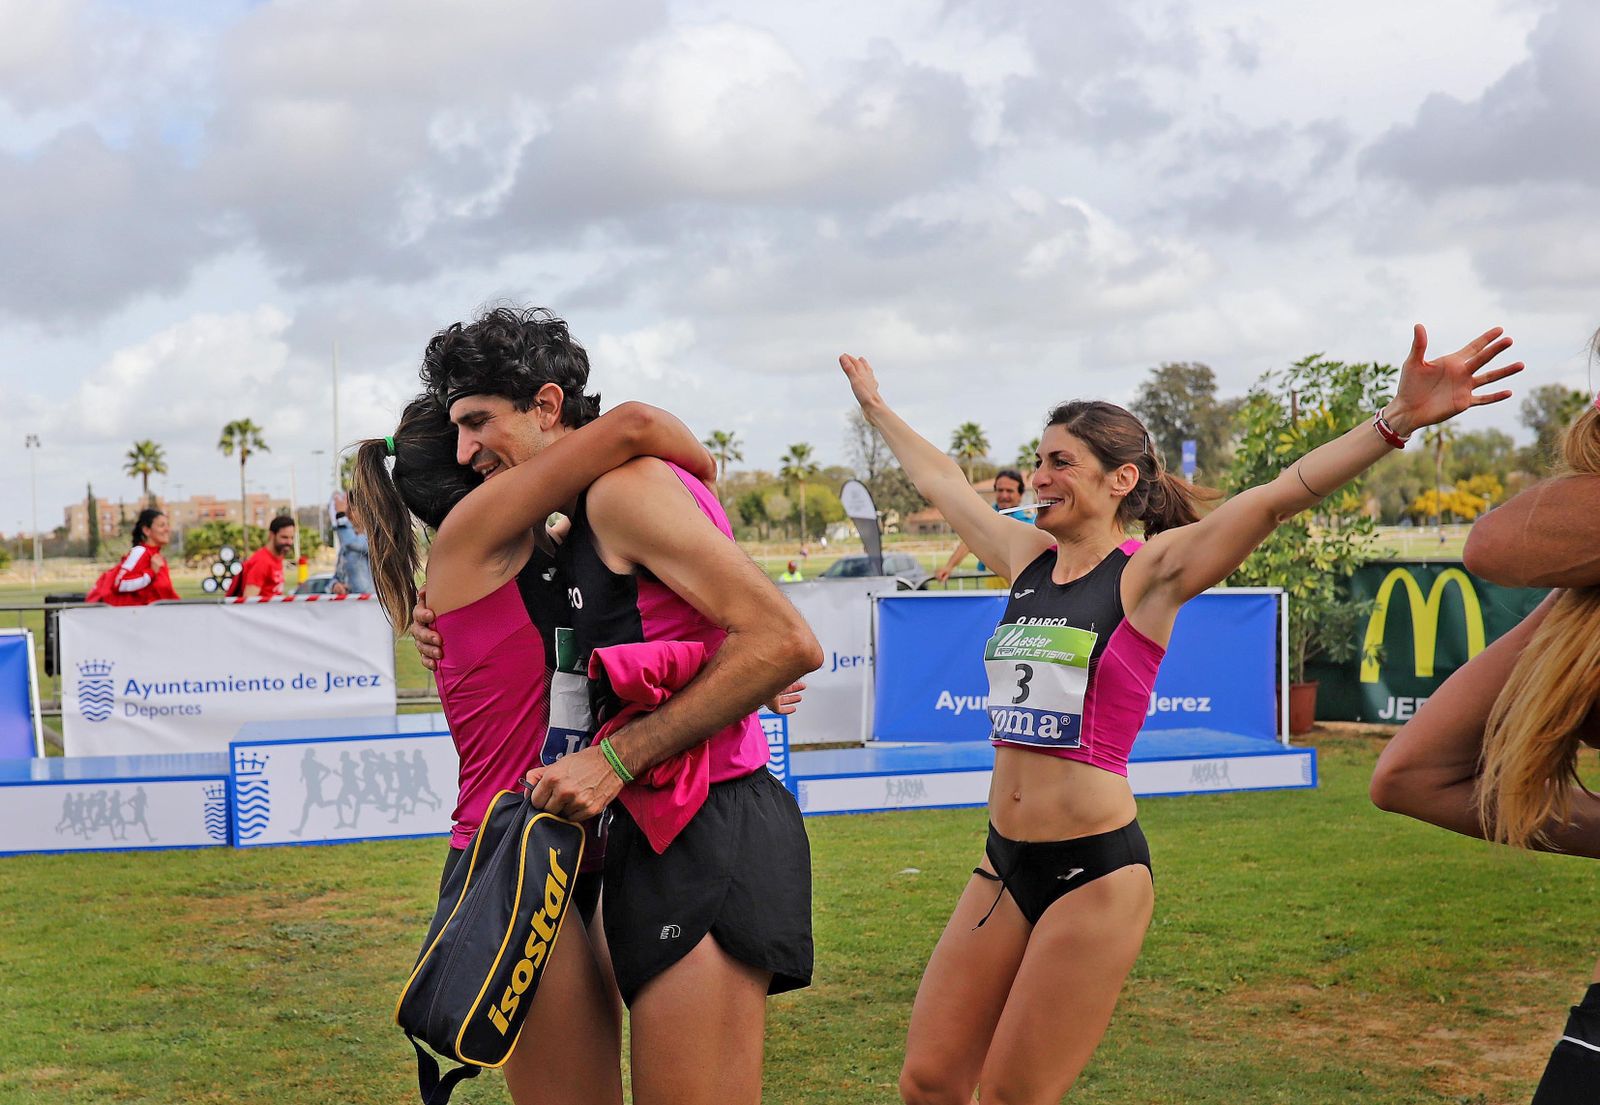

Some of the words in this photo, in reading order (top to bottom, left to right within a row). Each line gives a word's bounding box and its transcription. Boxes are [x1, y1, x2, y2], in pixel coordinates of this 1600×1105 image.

[1028, 617, 1068, 627] BARCO
[997, 627, 1052, 648] Master
[124, 673, 285, 700] Ayuntamiento
[292, 673, 317, 691] de
[324, 671, 381, 693] Jerez
[1011, 663, 1034, 705] 3
[124, 702, 202, 719] Deportes
[1146, 691, 1212, 717] Jerez
[487, 846, 568, 1036] isostar
